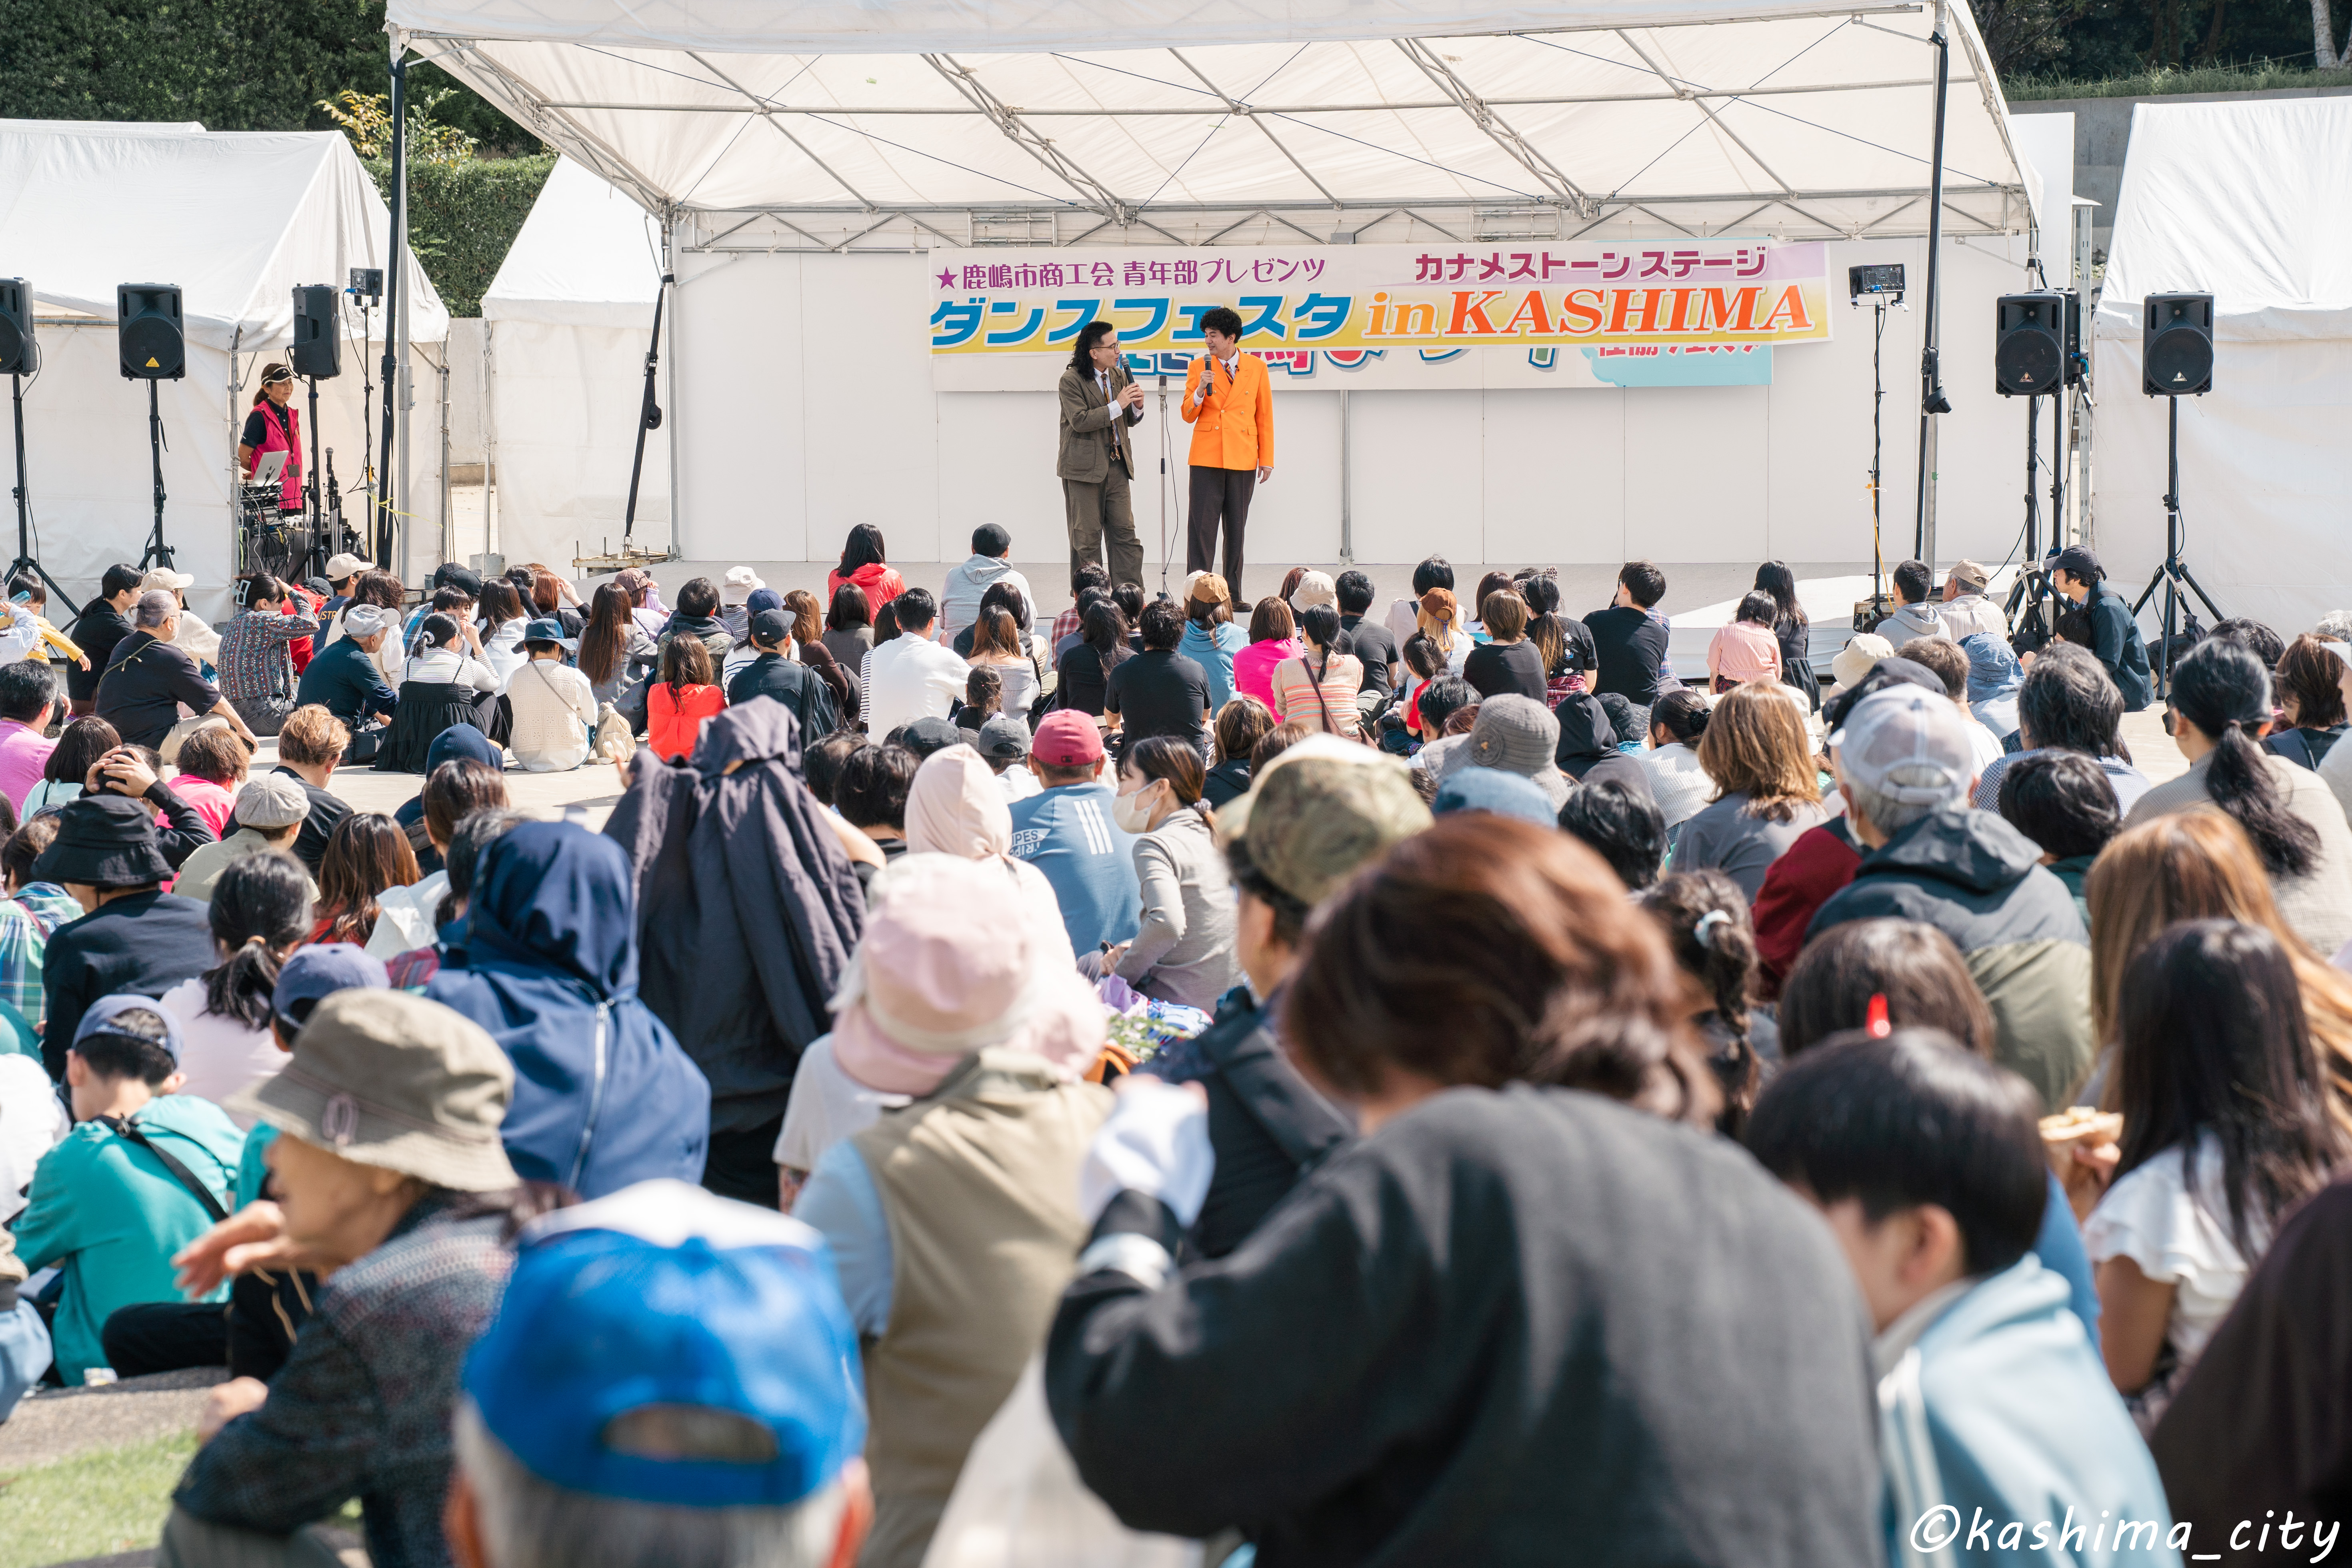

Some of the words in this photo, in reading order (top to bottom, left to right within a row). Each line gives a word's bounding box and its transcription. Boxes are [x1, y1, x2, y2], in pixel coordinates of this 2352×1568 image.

[963, 262, 1114, 290] 鹿嶋市商工会
[1124, 258, 1325, 286] 青年部プレゼンツ
[1416, 252, 1630, 281] カナメストーン
[1640, 247, 1766, 278] ステージ
[931, 293, 1351, 345] ダンスフェスタ
[1364, 292, 1435, 335] in
[1444, 285, 1812, 335] KASHIMA
